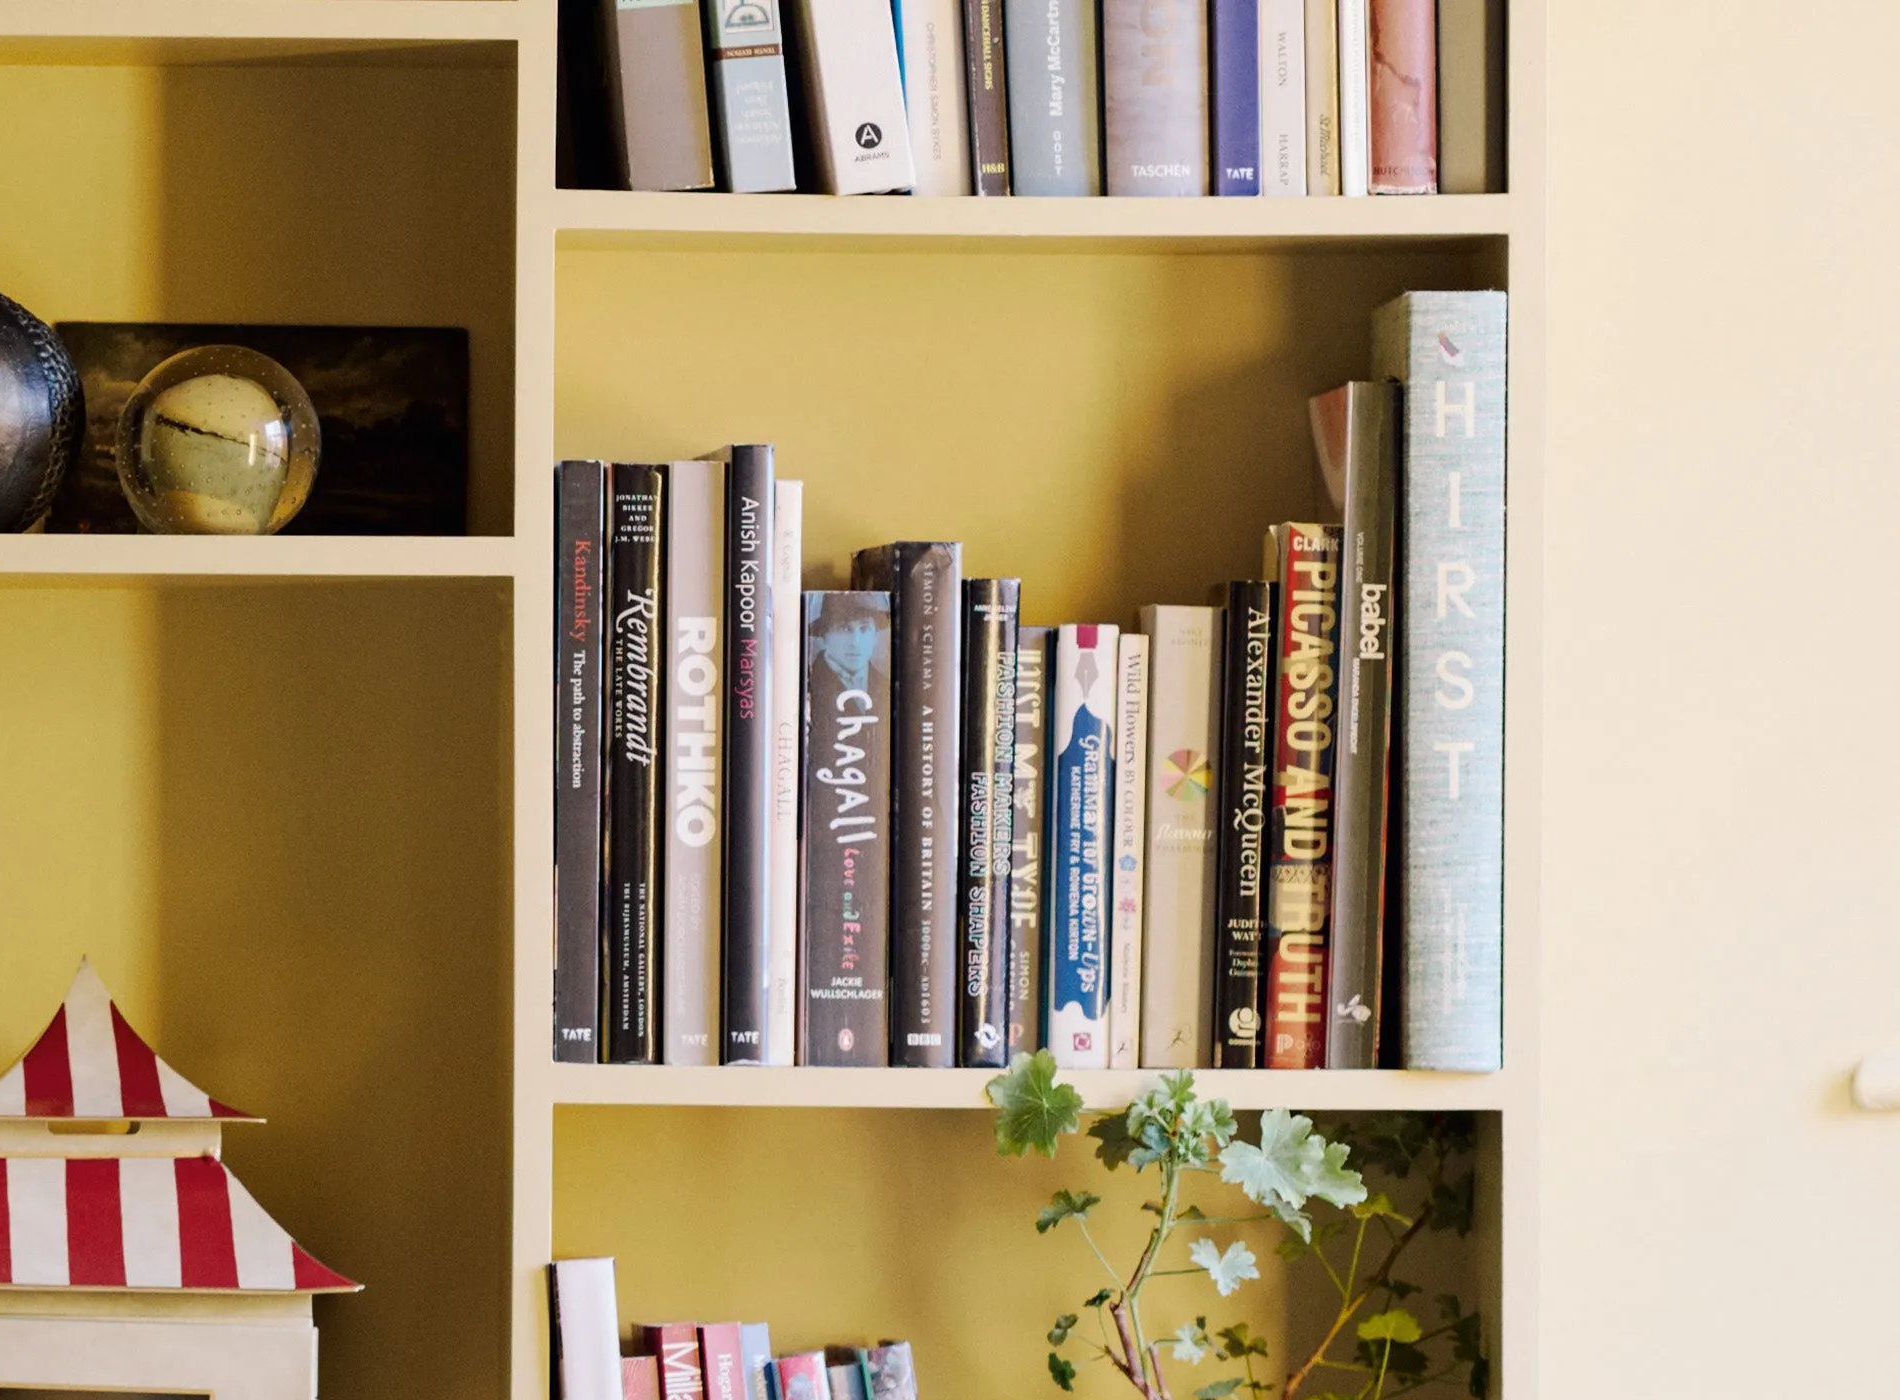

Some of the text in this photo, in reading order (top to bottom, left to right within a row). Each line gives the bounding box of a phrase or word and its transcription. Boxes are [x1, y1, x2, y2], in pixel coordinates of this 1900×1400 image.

[925, 21, 943, 163] CHRISTOPHER SIMON SYKES
[1276, 31, 1289, 88] WALTON
[1131, 163, 1192, 178] TASCHEN
[1225, 166, 1255, 181] TATE
[1277, 133, 1290, 187] HARRAP
[1293, 535, 1339, 552] CLARK
[1432, 377, 1476, 803] HIRST
[569, 539, 593, 789] Kandinsky The path to abstraction
[733, 496, 761, 720] Anish Kapoor Marsyas
[1358, 583, 1388, 660] babel
[614, 638, 624, 740] THE LATE WORKS
[615, 588, 658, 768] Rembrandt
[675, 616, 718, 848] ROTHKO
[776, 721, 793, 821] CHAGALL
[992, 651, 1017, 877] FASHION MAKERS
[1121, 654, 1143, 848] Wild Flowers BY COLOUR
[1233, 606, 1271, 898] Alexander McQueen
[1276, 560, 1339, 1024] PICASSO AND TRUTH
[967, 771, 993, 998] FASHION SHAPERS
[561, 1027, 592, 1042] TATE
[681, 1034, 709, 1047] TATE
[730, 1030, 760, 1045] TATE
